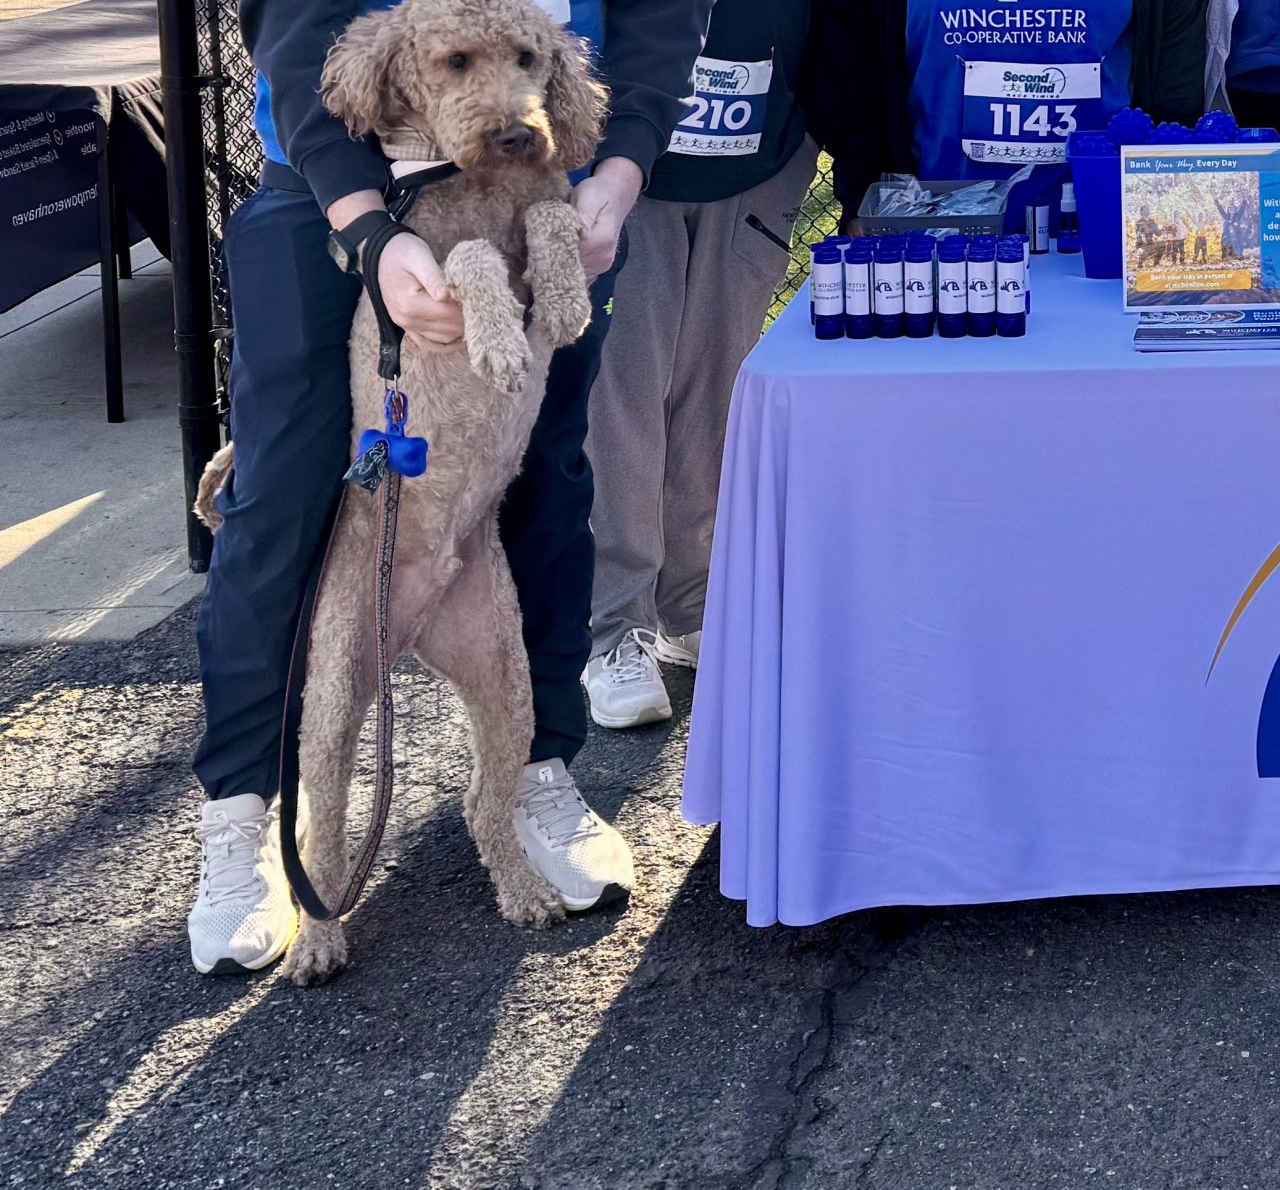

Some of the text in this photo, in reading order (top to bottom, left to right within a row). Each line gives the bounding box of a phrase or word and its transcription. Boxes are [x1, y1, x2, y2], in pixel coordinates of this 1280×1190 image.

[940, 9, 1087, 29] WINCHESTER
[944, 31, 1086, 45] CO-OPERATIVE BANK
[696, 67, 737, 80] econd
[1003, 71, 1050, 83] Second
[708, 77, 739, 90] Wind
[1024, 83, 1055, 93] Wind
[677, 97, 752, 131] 210
[990, 103, 1077, 137] 1143
[1196, 159, 1220, 168] Every
[1221, 159, 1238, 168] Day
